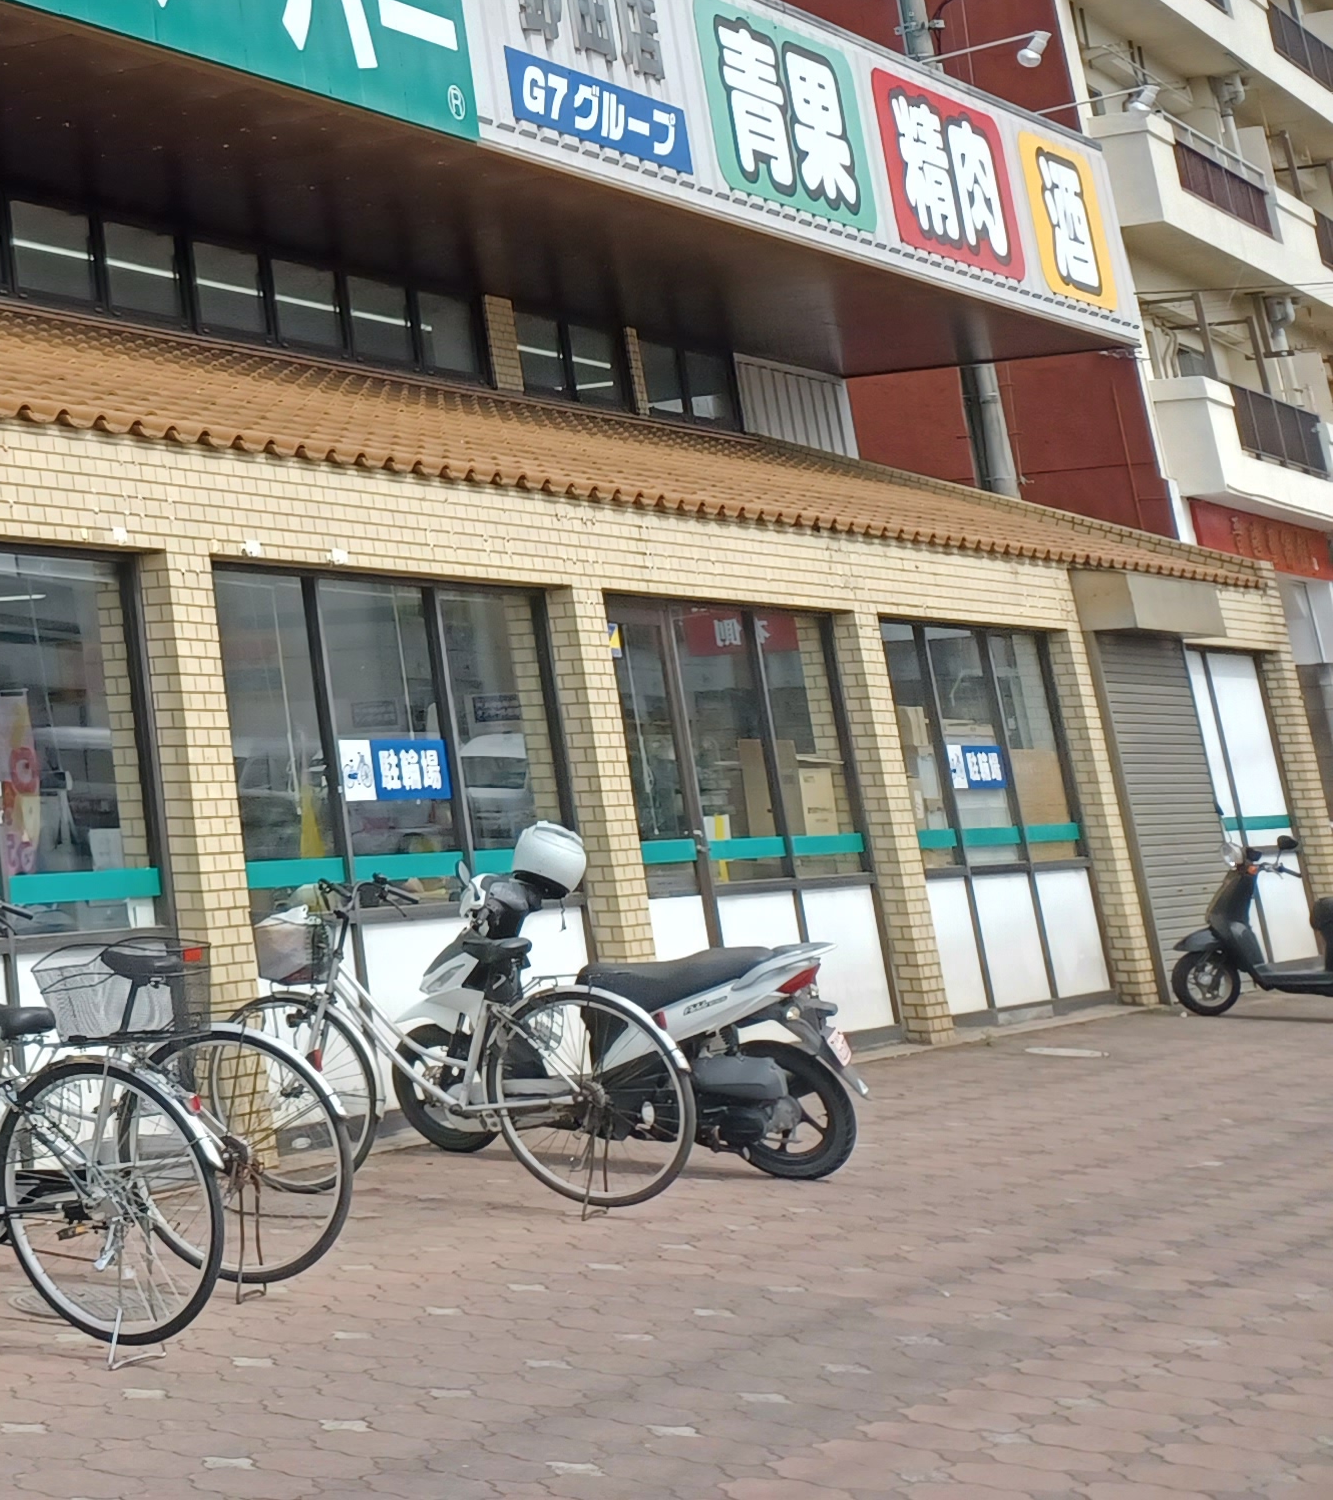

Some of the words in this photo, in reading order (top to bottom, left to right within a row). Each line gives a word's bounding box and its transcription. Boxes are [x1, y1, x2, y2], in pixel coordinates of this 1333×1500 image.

[715, 18, 859, 211] 青果
[890, 89, 1011, 262] 精肉
[1038, 150, 1102, 294] 酒
[377, 748, 443, 791] 駐輪場
